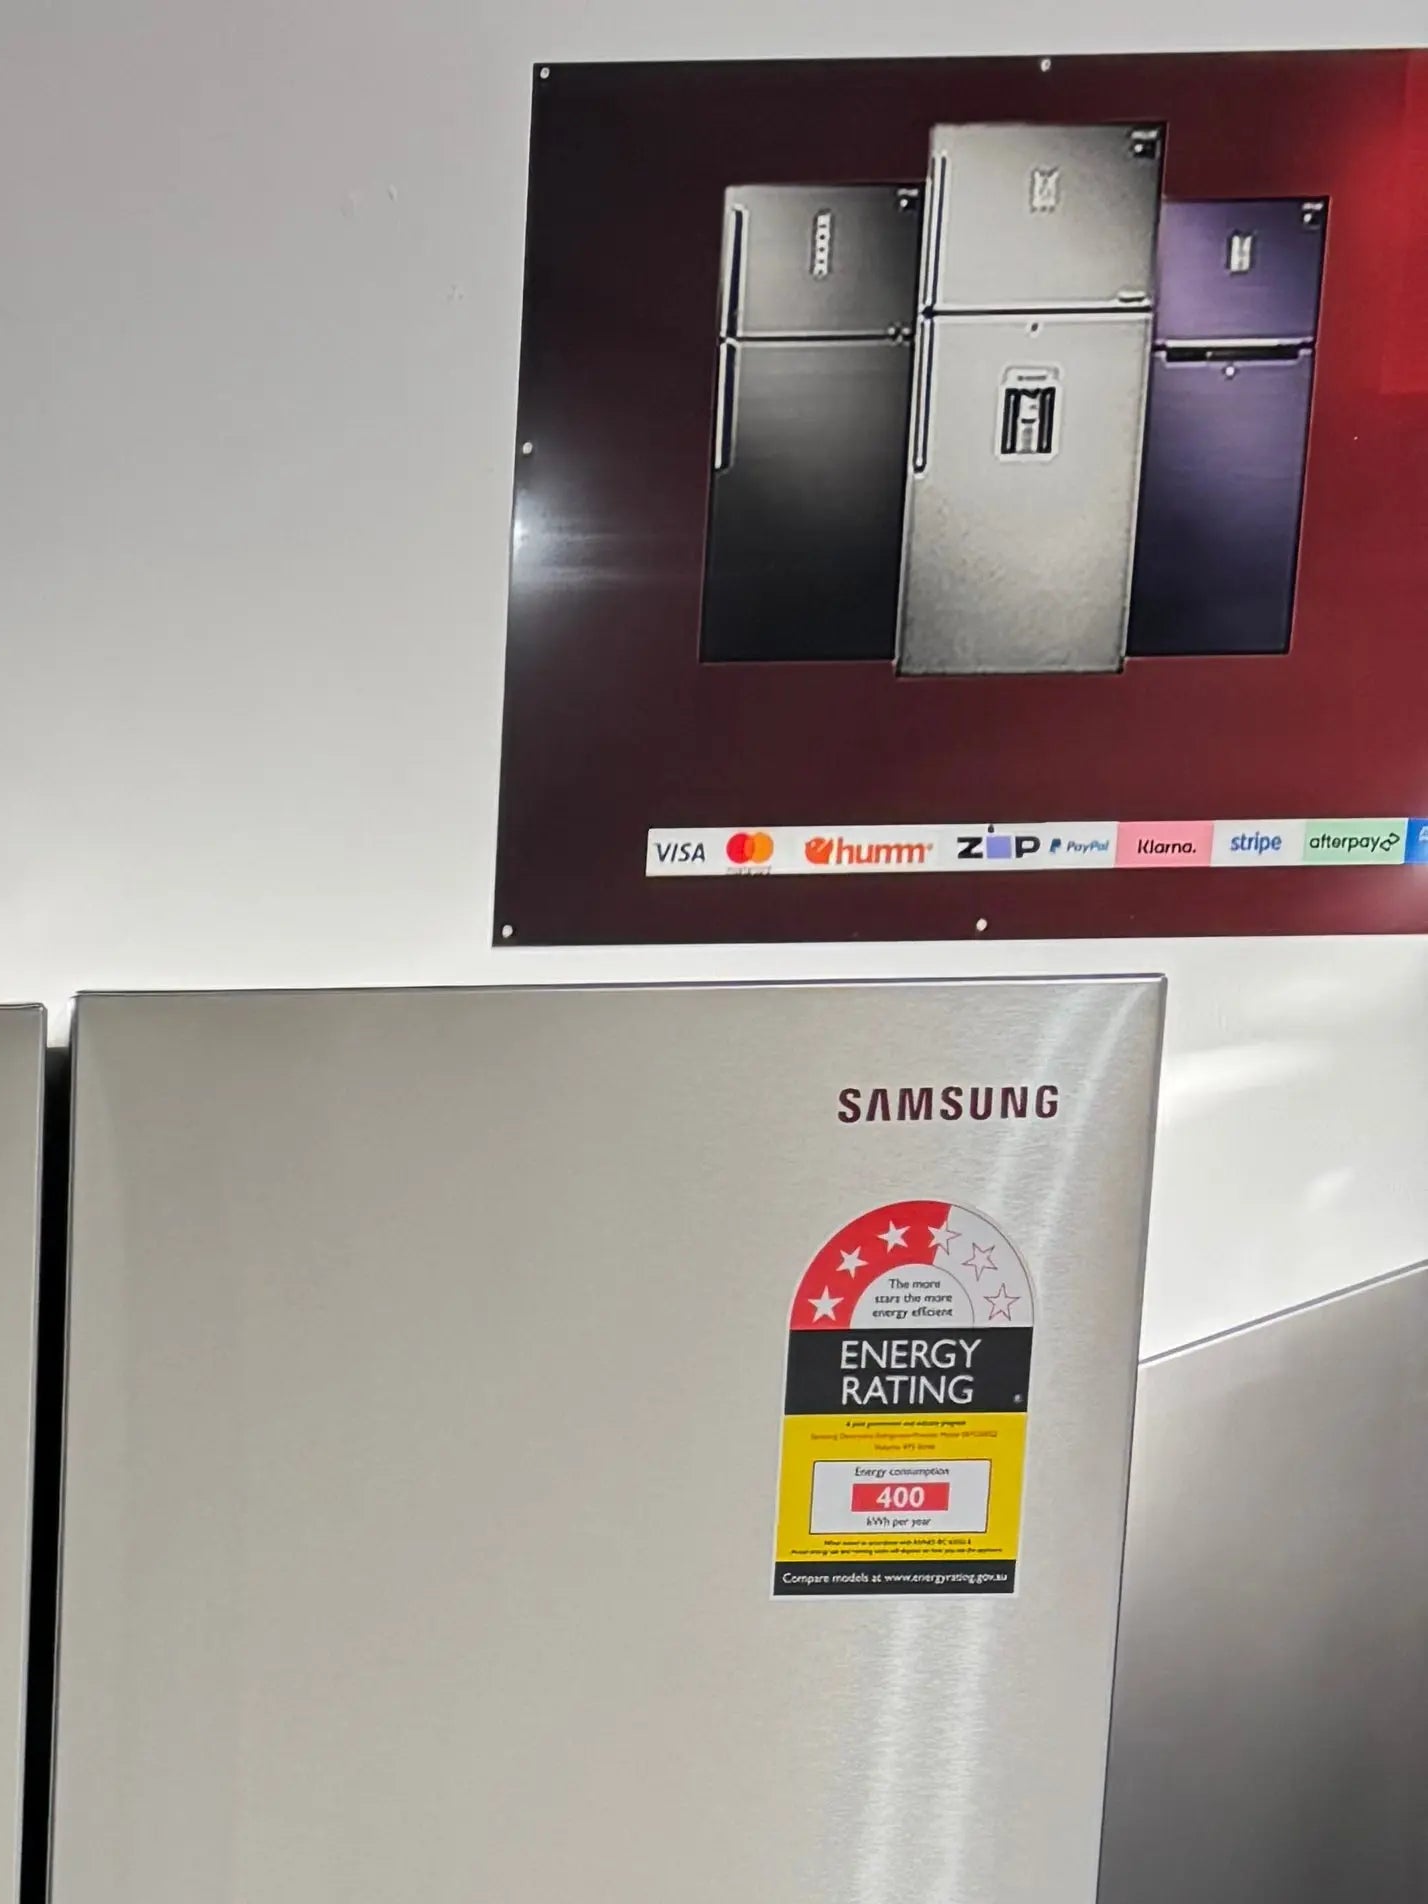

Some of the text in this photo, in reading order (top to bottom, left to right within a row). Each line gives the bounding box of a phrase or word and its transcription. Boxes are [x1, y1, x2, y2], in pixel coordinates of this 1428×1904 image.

[654, 842, 706, 863] VISA
[836, 837, 930, 864] humm
[1066, 839, 1110, 853] PayPal
[1230, 831, 1282, 856] stripe
[1309, 833, 1381, 853] afterpay
[837, 1085, 1059, 1124] SAMSUNG
[888, 1278, 941, 1289] The more
[903, 1293, 921, 1303] the
[924, 1294, 953, 1303] more
[872, 1309, 909, 1320] energy
[840, 1338, 982, 1370] ENERGY
[841, 1374, 976, 1405] RATING
[855, 1466, 950, 1478] Energy consumption
[875, 1486, 925, 1508] 400
[866, 1516, 932, 1528] kWh per year
[782, 1572, 829, 1585] Compare
[832, 1572, 869, 1584] models
[871, 1573, 882, 1583] at
